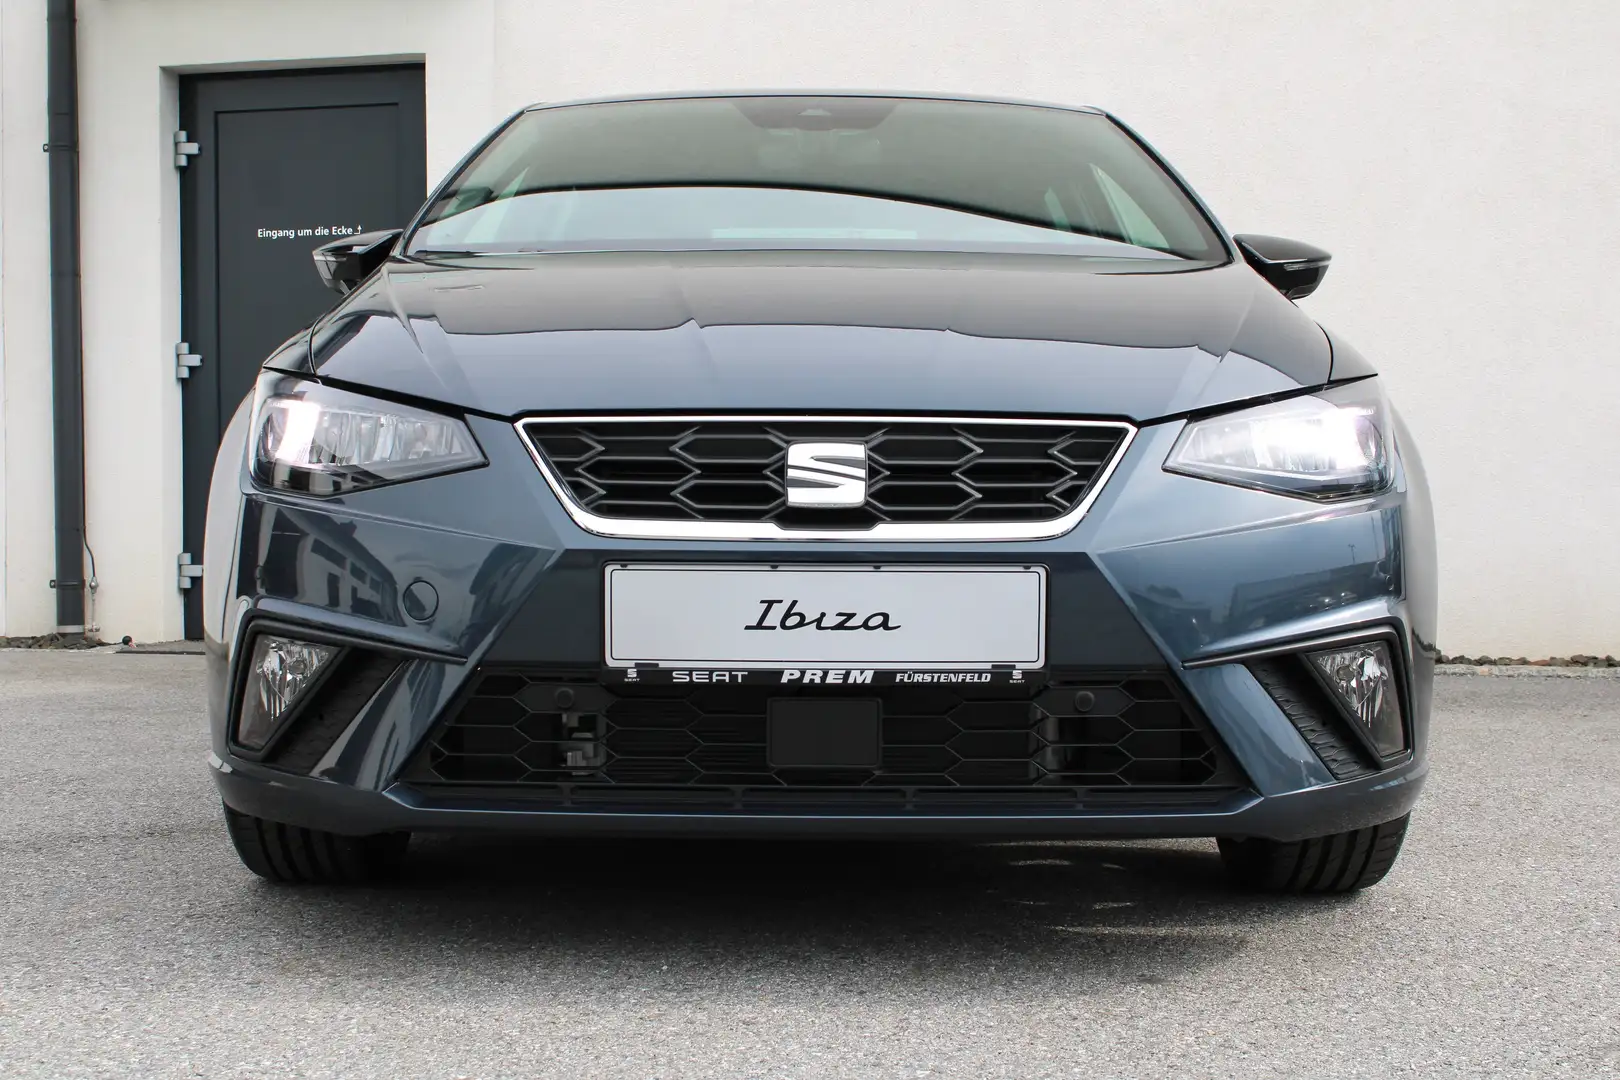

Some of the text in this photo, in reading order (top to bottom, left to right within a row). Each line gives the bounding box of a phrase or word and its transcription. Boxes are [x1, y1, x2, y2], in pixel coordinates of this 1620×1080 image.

[257, 228, 295, 239] Eingang
[314, 226, 330, 236] die
[331, 225, 353, 235] Ecke
[744, 600, 901, 631] Ibiza
[672, 669, 992, 684] SEAT PREM FÜRSTENFELD
